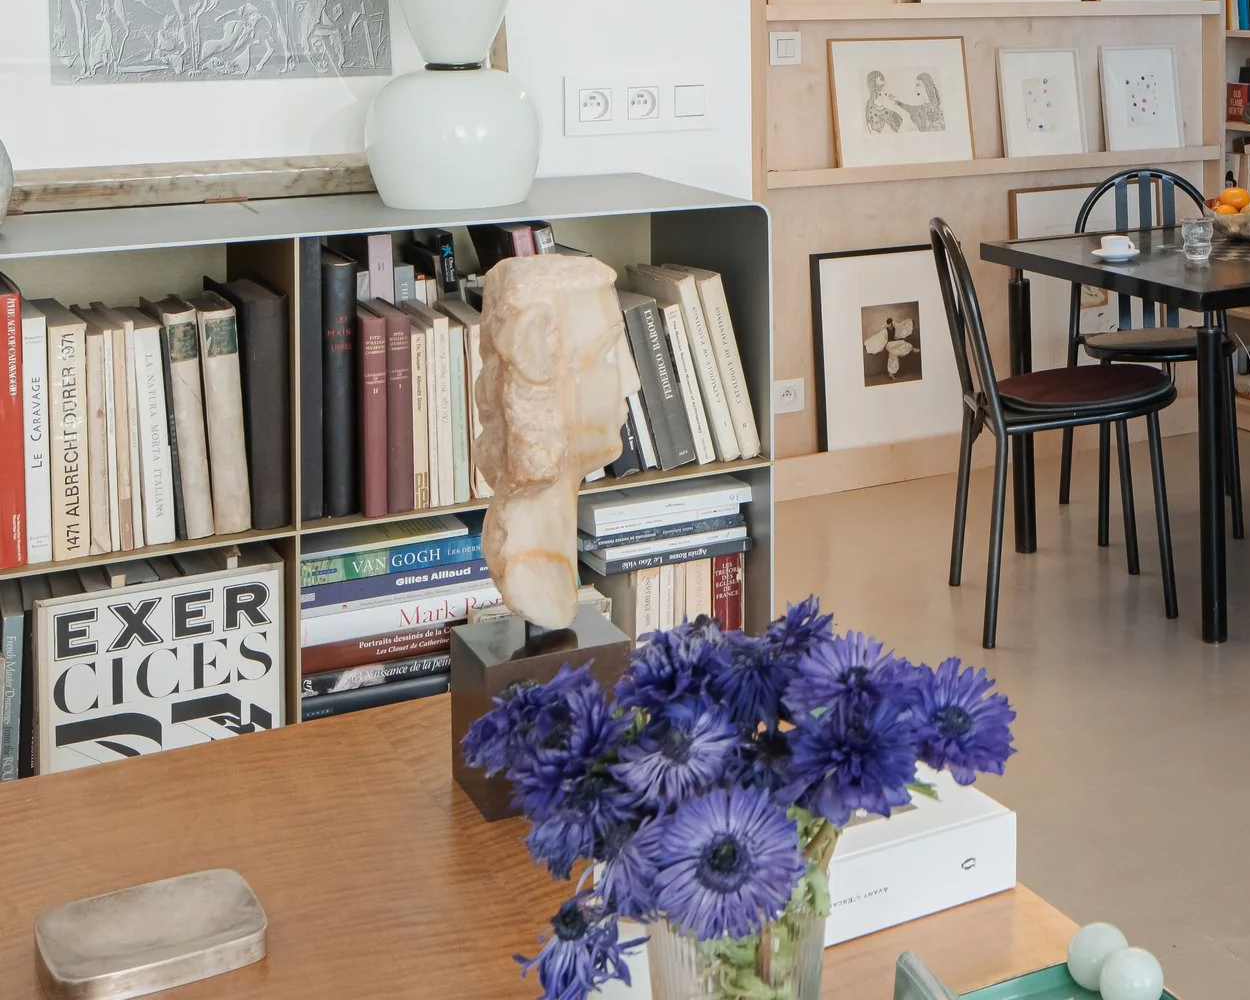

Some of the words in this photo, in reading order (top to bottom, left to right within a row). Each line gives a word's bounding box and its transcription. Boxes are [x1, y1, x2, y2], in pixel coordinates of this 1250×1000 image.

[8, 318, 16, 336] AGE
[643, 309, 661, 352] BAROCCI
[146, 354, 154, 368] LA
[655, 352, 674, 400] FEDERICO
[147, 374, 159, 417] NATURA
[30, 376, 42, 442] CARAVAGE
[151, 424, 161, 462] MORTA
[31, 453, 42, 469] LE
[63, 430, 80, 517] ALBRECHT
[154, 468, 164, 519] ITALIANA
[66, 522, 81, 552] 1471
[352, 556, 387, 574] VAN
[391, 548, 441, 567] GOGH
[447, 547, 460, 556] LES
[653, 556, 663, 564] Le
[669, 552, 688, 560] Rosse
[688, 548, 708, 558] Agnès
[396, 574, 428, 586] Gilles
[430, 567, 471, 581] Aillaud
[621, 561, 637, 570] vidé
[722, 573, 733, 581] DES
[716, 590, 739, 600] FRANCE
[53, 581, 273, 662] EXER
[400, 599, 456, 628] Mark
[5, 635, 16, 660] French
[359, 636, 392, 649] Portraits
[393, 630, 424, 643] dessinés
[425, 629, 434, 638] de
[435, 627, 442, 636] la
[376, 647, 386, 655] Les
[386, 644, 409, 654] Clouet
[409, 642, 417, 650] de
[418, 637, 450, 648] Catherine
[5, 661, 16, 688] Master
[53, 630, 273, 714] CICES
[365, 664, 408, 681] Naissance
[409, 661, 421, 672] de
[422, 659, 432, 670] la
[863, 887, 889, 901] AVANT
